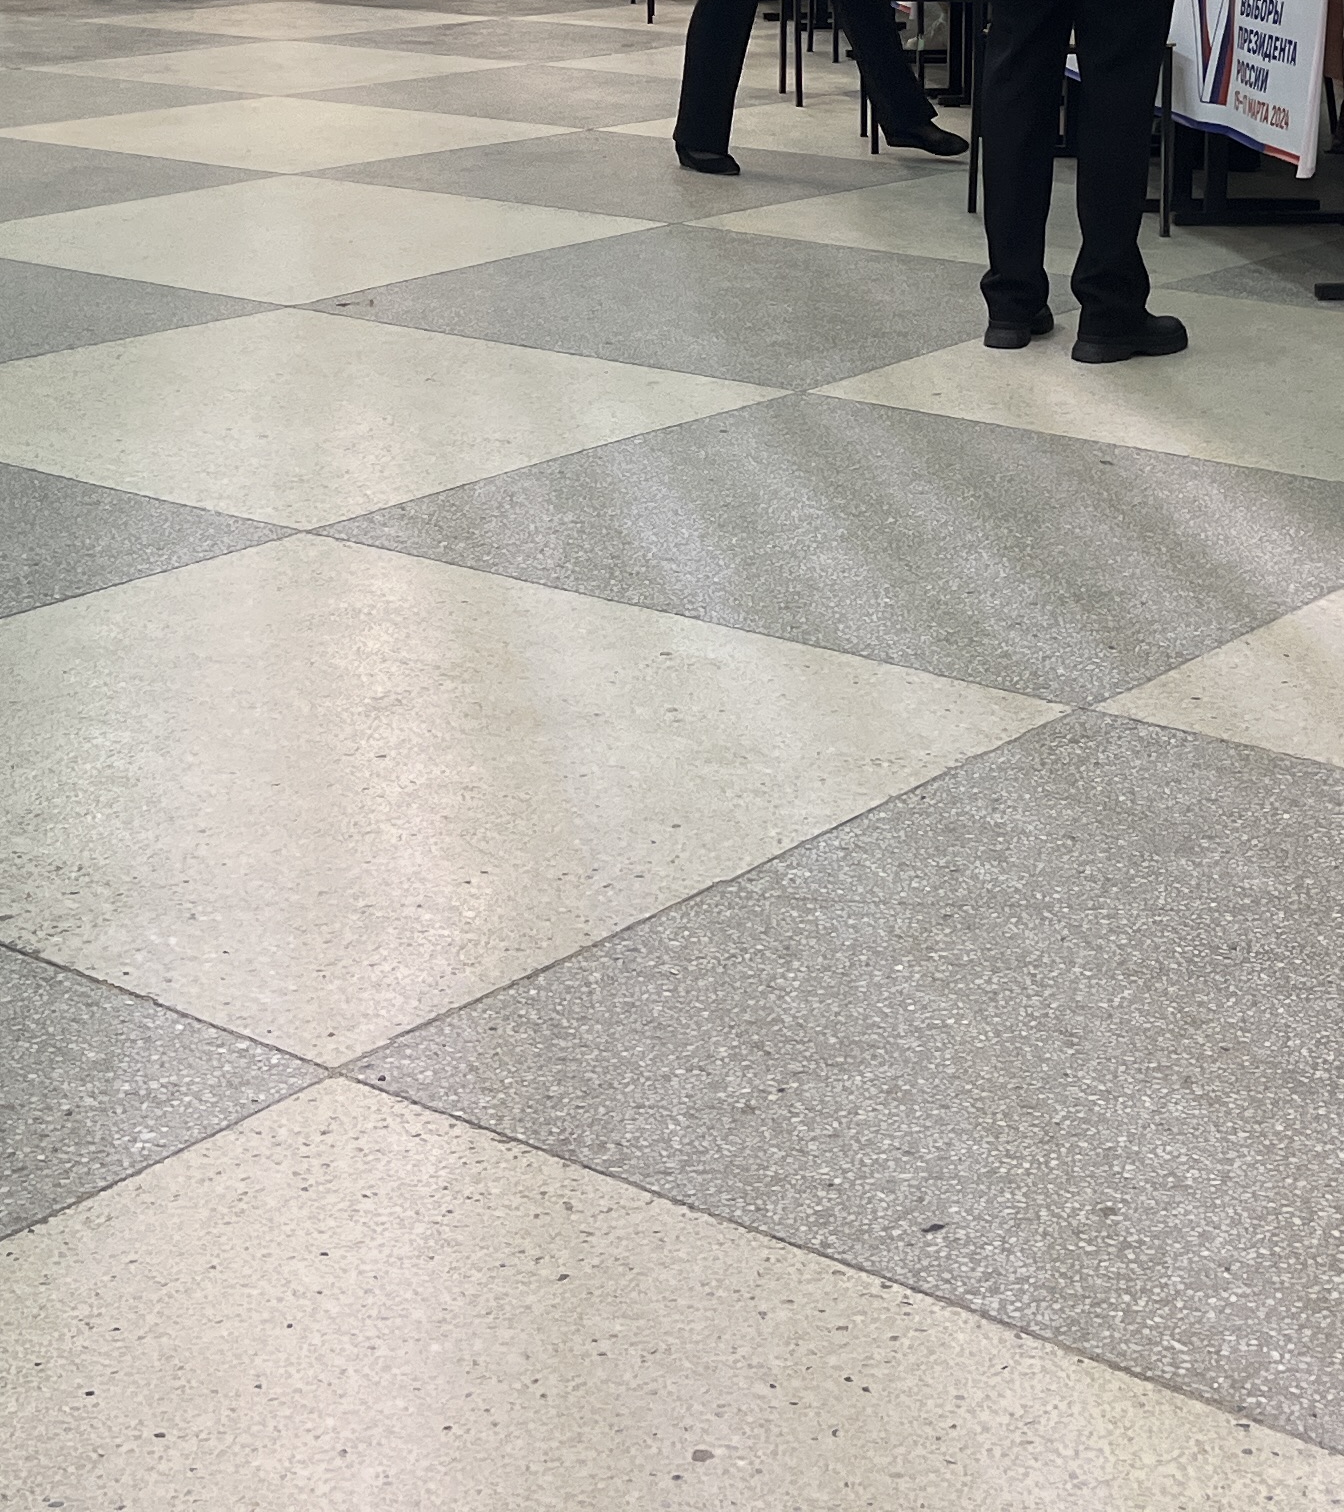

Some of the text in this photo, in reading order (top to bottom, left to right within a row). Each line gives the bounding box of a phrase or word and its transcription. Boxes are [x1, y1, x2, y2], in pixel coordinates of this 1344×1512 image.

[1237, 25, 1298, 66] ПРЕЗИДЕНТА
[1236, 58, 1270, 93] РОССИИ
[1270, 104, 1289, 131] 2024
